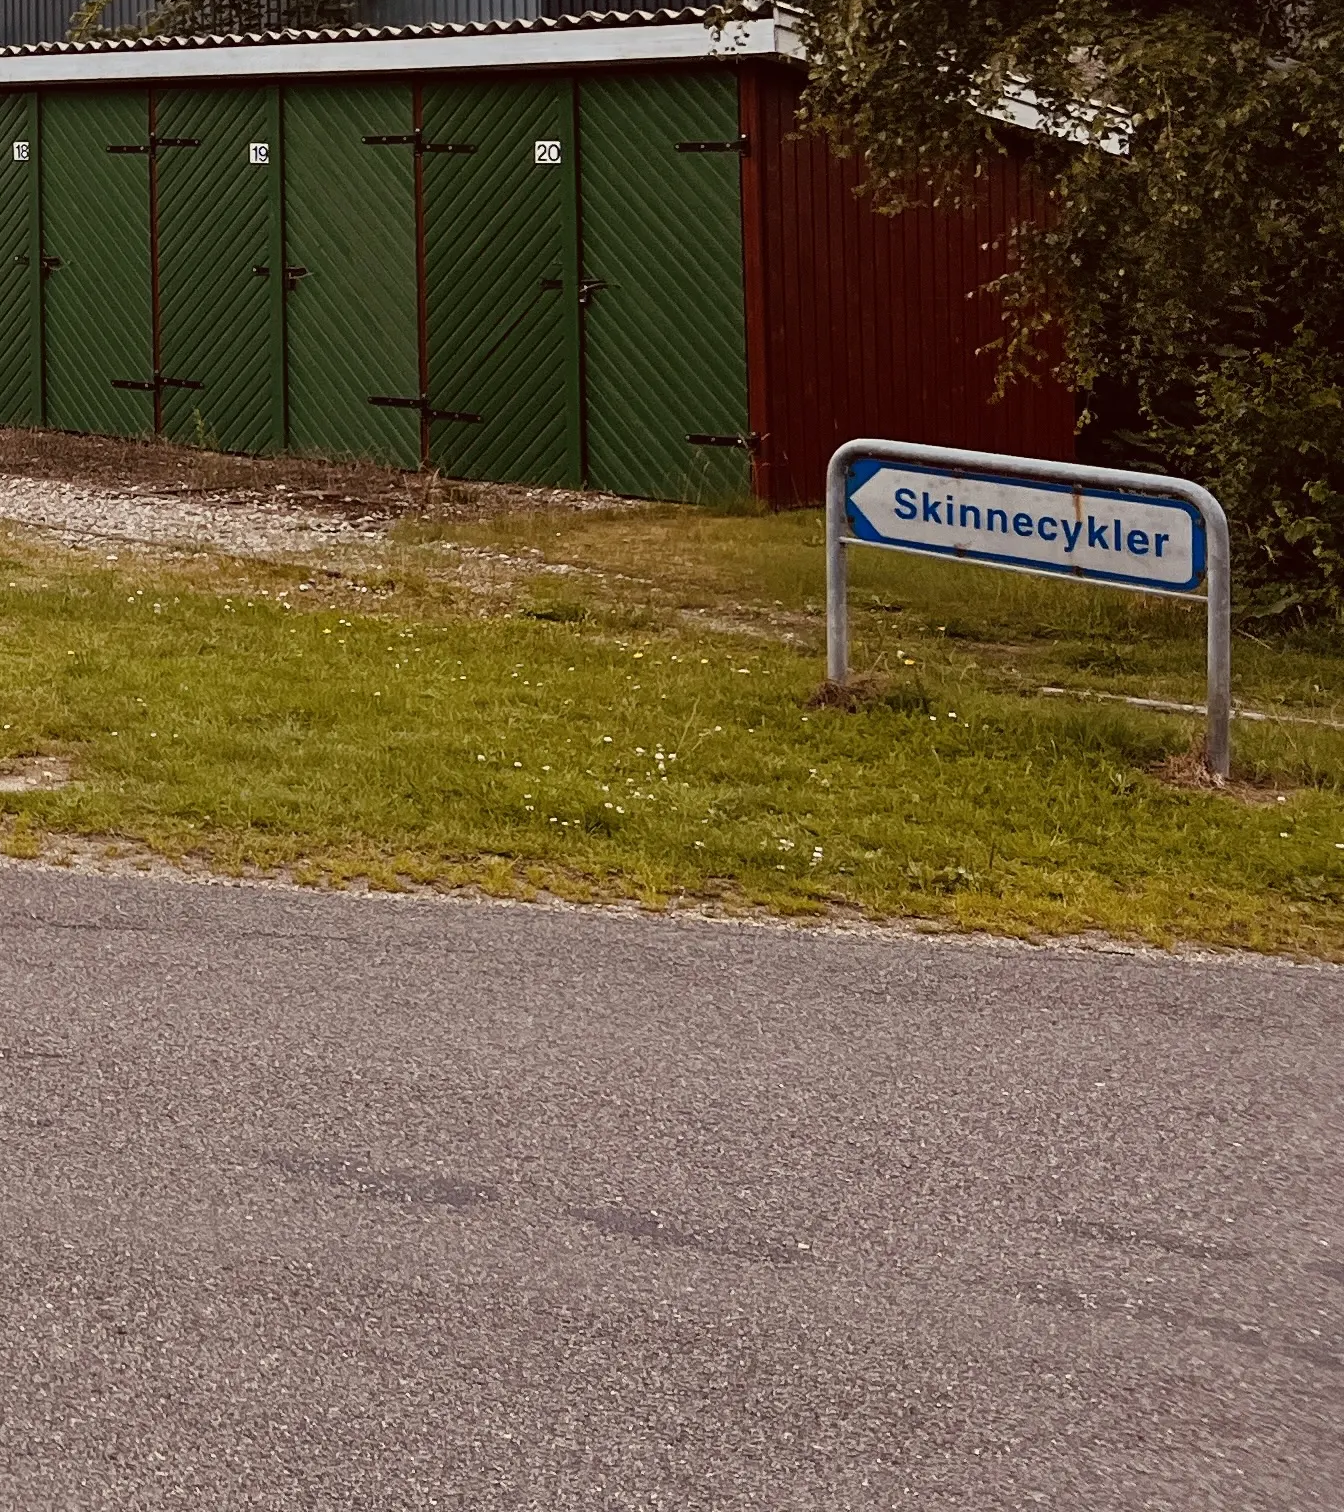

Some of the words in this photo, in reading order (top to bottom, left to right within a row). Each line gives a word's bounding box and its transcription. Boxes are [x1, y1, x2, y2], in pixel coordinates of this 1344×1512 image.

[16, 144, 30, 159] 18
[252, 146, 269, 162] 19
[537, 144, 561, 163] 20
[893, 487, 1170, 558] Skinnecykler
